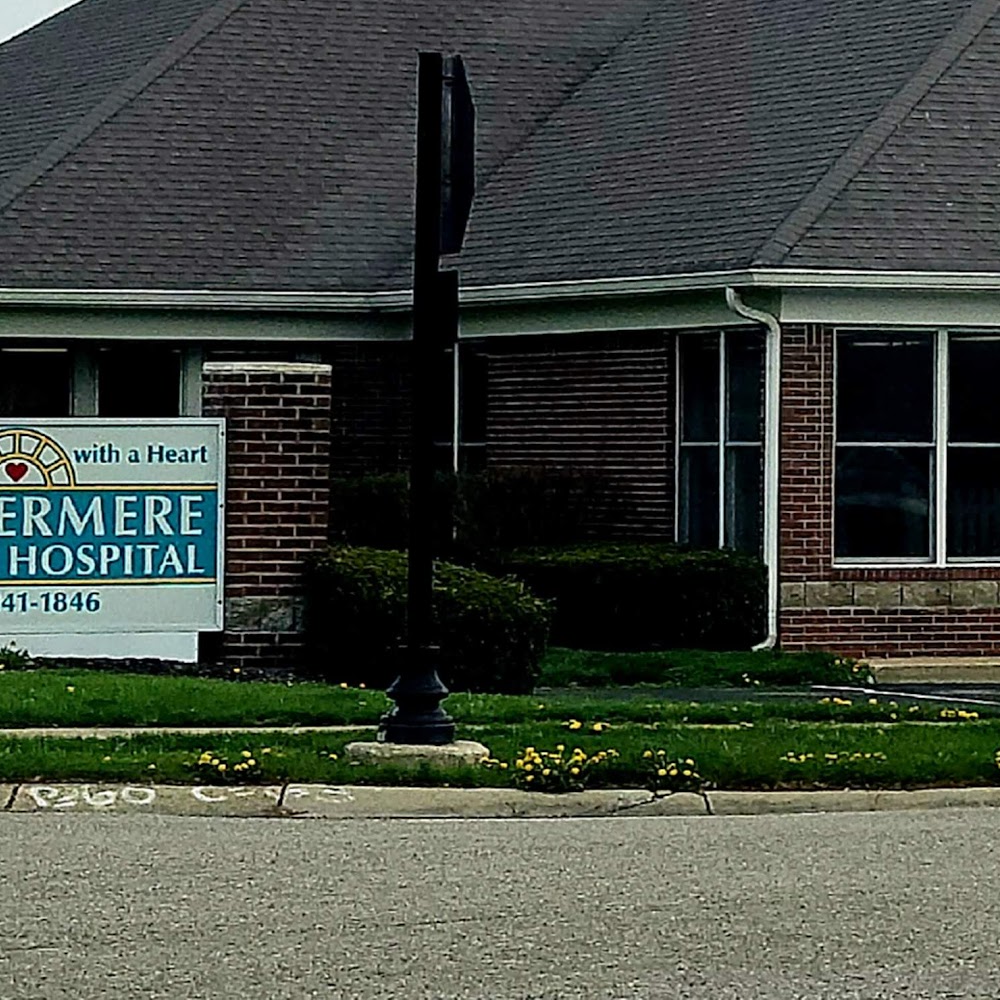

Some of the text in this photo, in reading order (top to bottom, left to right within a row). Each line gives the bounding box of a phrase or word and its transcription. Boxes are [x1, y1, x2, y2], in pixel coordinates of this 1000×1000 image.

[74, 443, 208, 464] with a Heart
[0, 495, 203, 537] ERMERE
[9, 544, 205, 576] HOSPITAL
[1, 591, 101, 613] 41-1846
